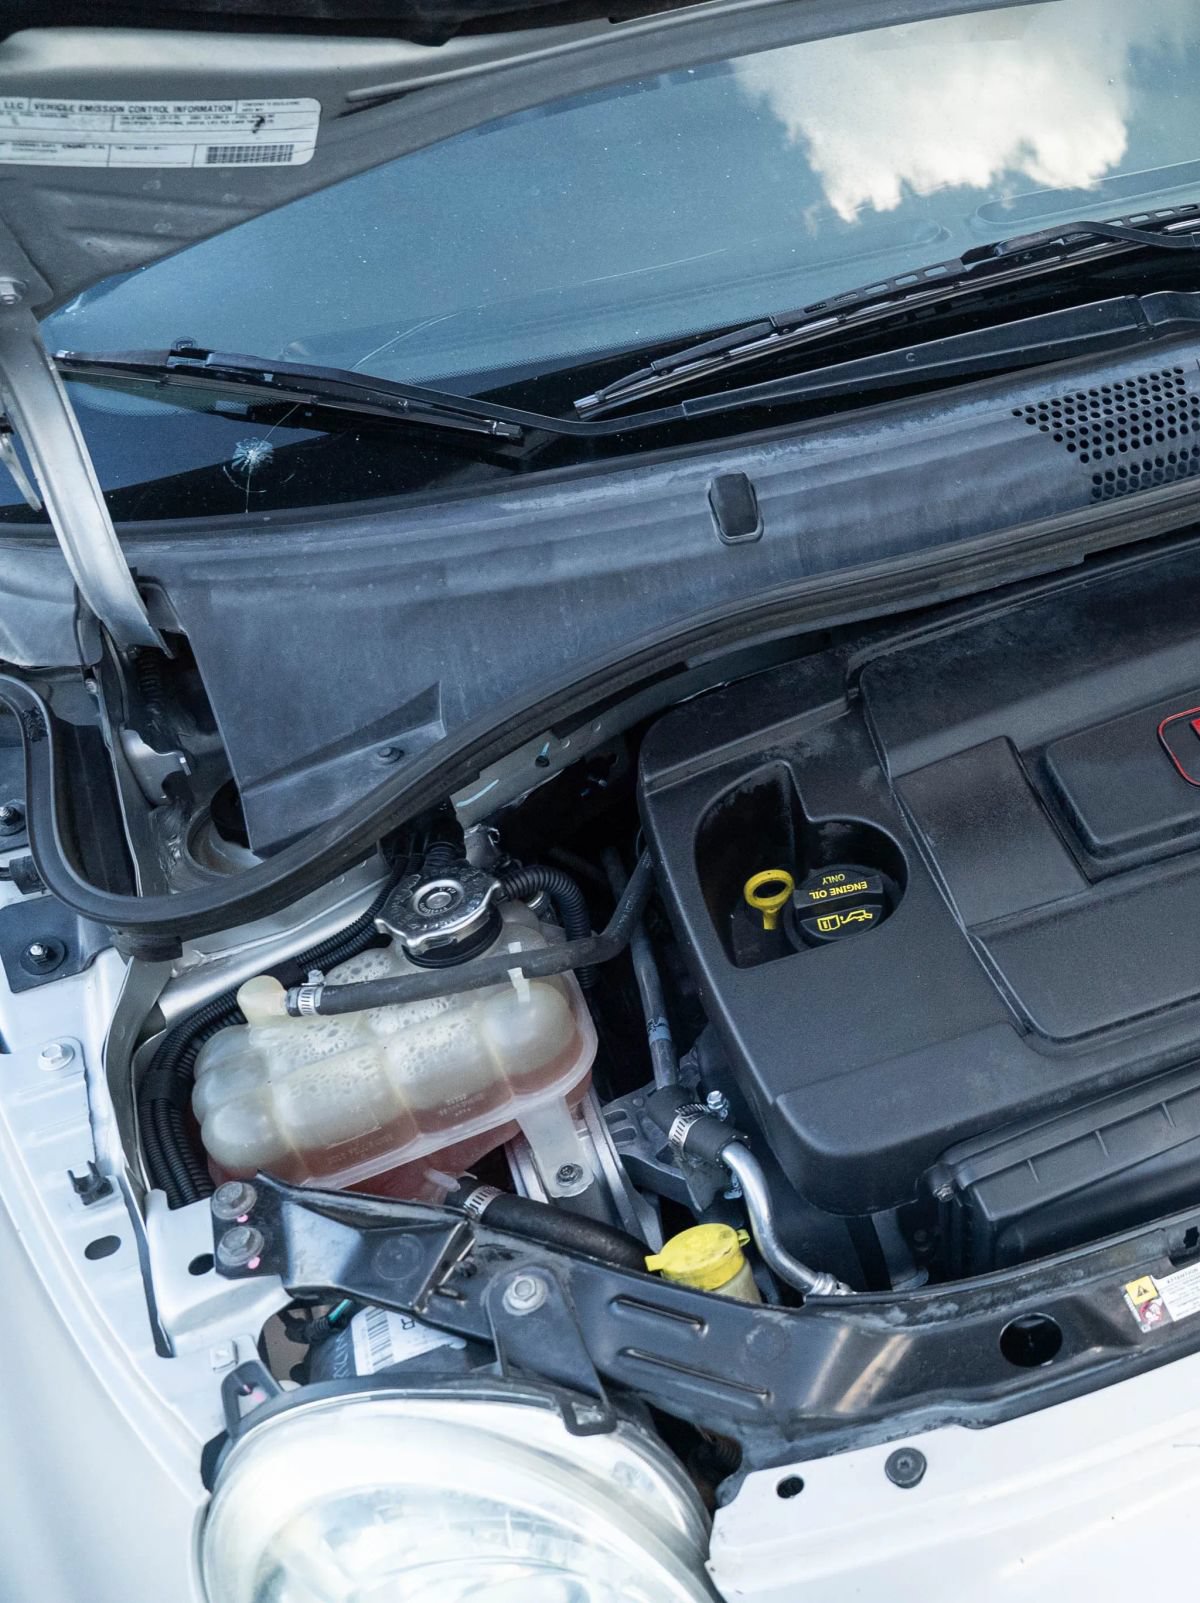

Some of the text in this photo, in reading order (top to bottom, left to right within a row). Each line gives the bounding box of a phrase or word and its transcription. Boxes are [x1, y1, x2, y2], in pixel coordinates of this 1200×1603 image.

[34, 104, 75, 113] VEHICLE
[79, 104, 125, 113] EMISSION
[128, 105, 168, 113] CONTROL
[173, 104, 233, 113] INFORMATION
[822, 873, 846, 886] ONLY
[809, 880, 868, 900] ENGINE OIL
